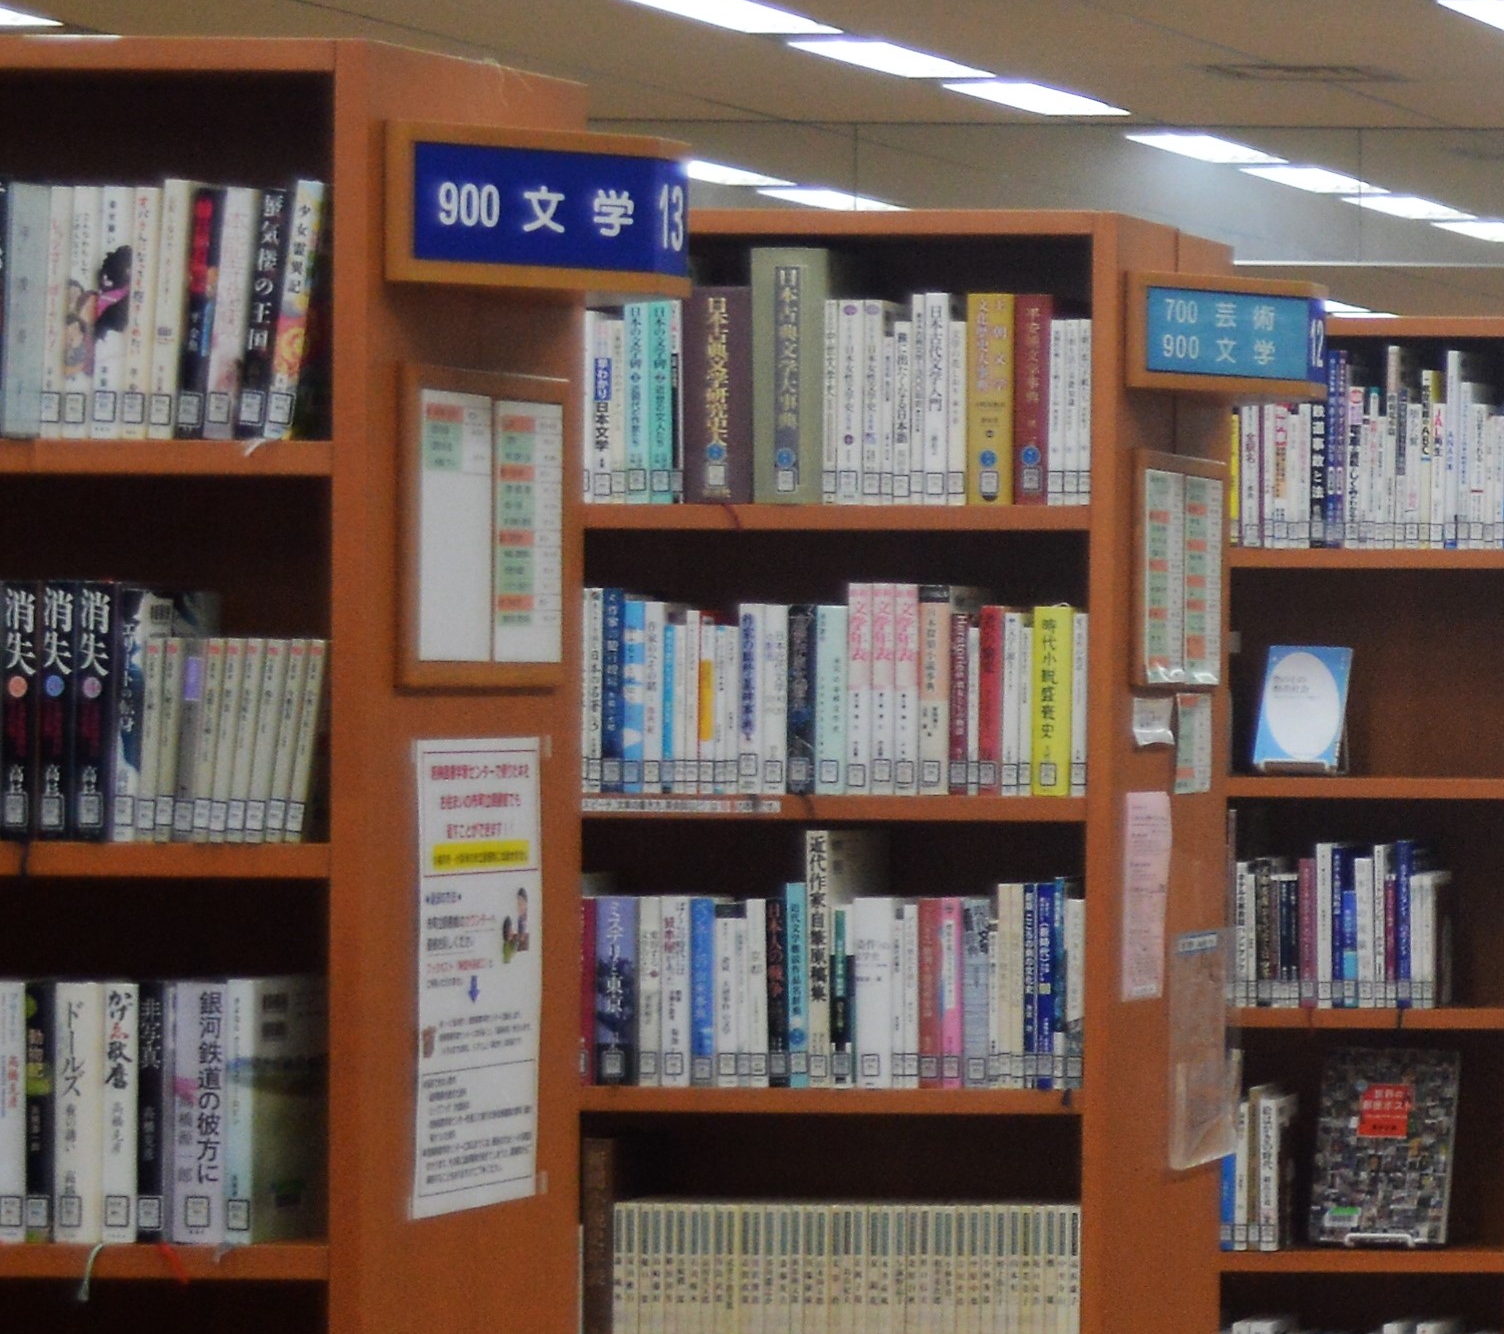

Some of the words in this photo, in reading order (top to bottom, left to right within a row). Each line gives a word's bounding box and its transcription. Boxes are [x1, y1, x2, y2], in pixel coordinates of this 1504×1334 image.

[439, 182, 501, 227] 900
[523, 189, 635, 236] 文学
[659, 187, 686, 251] 13
[249, 193, 292, 350] 蜃気楼の王国
[1164, 298, 1198, 325] 700
[1214, 302, 1276, 332] 芸術
[1162, 334, 1200, 361] 900
[1214, 337, 1276, 365] 文学
[1310, 318, 1326, 368] 12
[4, 587, 37, 677] 消失
[43, 586, 73, 676] 消失
[80, 587, 111, 678] 消失
[1040, 618, 1056, 741] 時代小説盛衰史
[808, 836, 828, 1003] 近代作家自筆原稿集
[61, 1001, 84, 1099] ドールズ
[196, 991, 223, 1185] 銀河鉄道の彼方に
